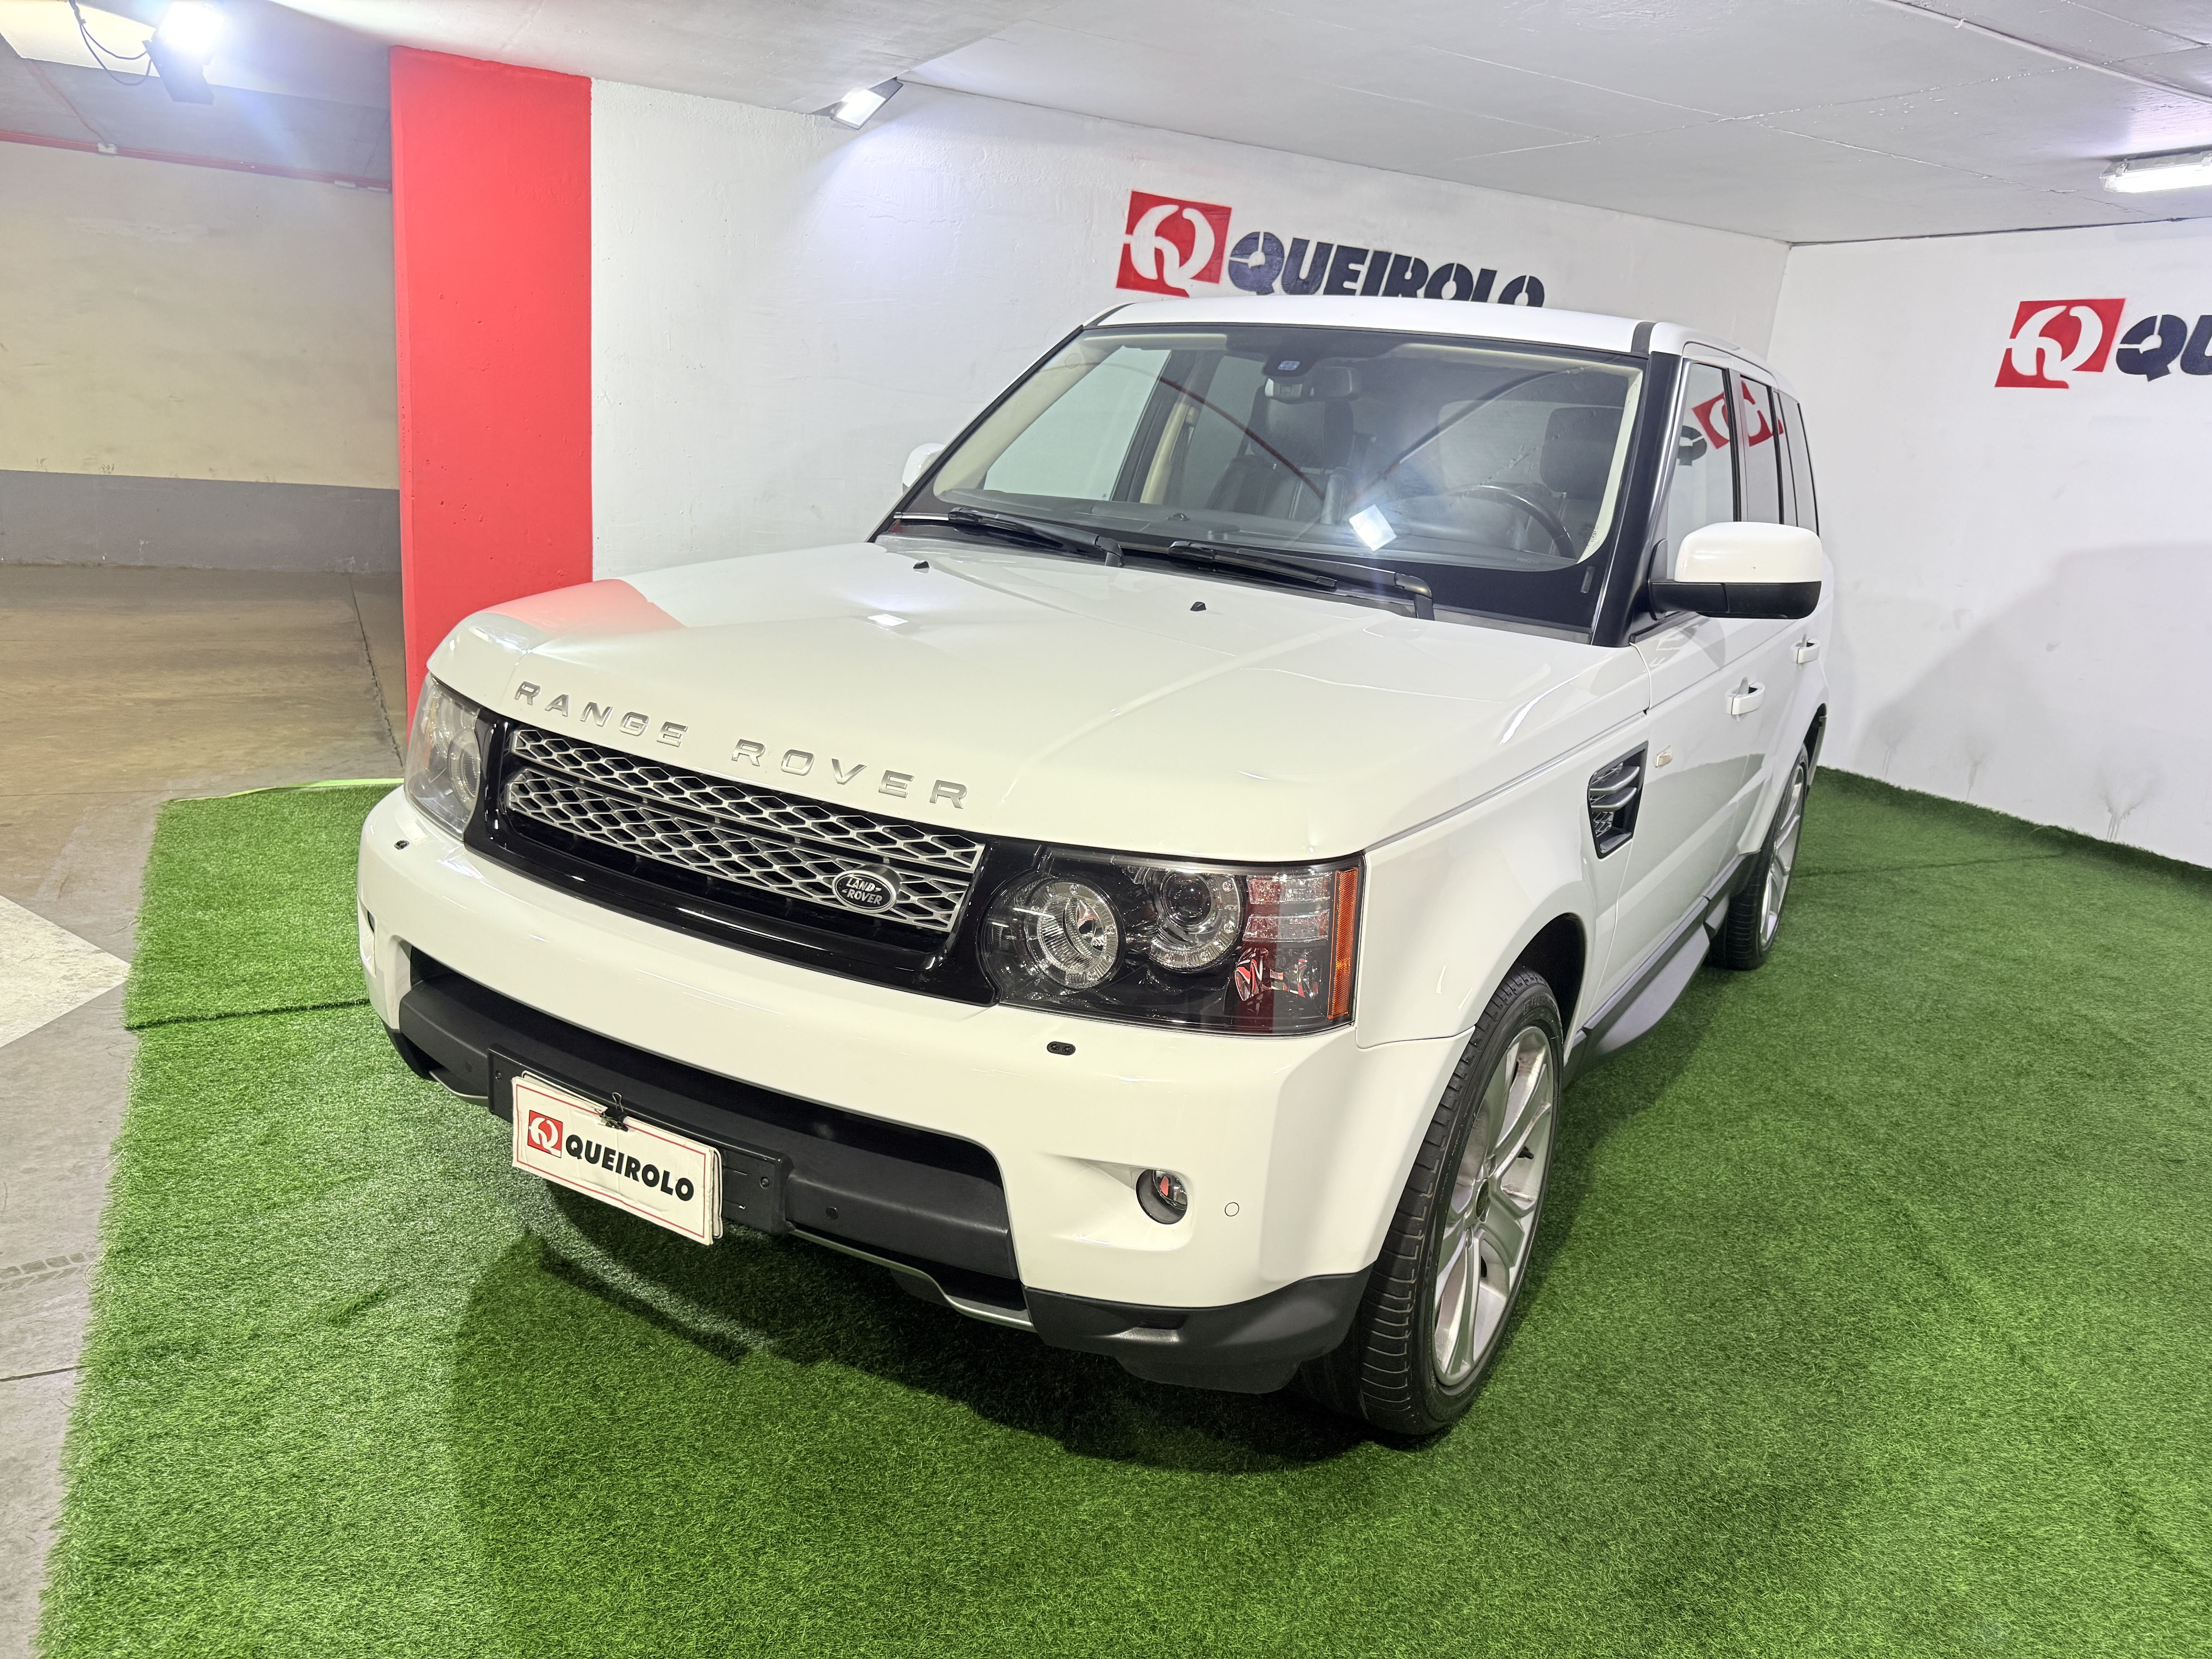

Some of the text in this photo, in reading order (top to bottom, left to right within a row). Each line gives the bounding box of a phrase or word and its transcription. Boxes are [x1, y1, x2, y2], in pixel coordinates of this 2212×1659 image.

[1228, 231, 1545, 307] QUEIROLO
[514, 681, 968, 809] RANGE ROVER
[846, 878, 876, 892] LAND
[847, 889, 883, 905] ROVER
[565, 1134, 694, 1201] QUEIROLO
